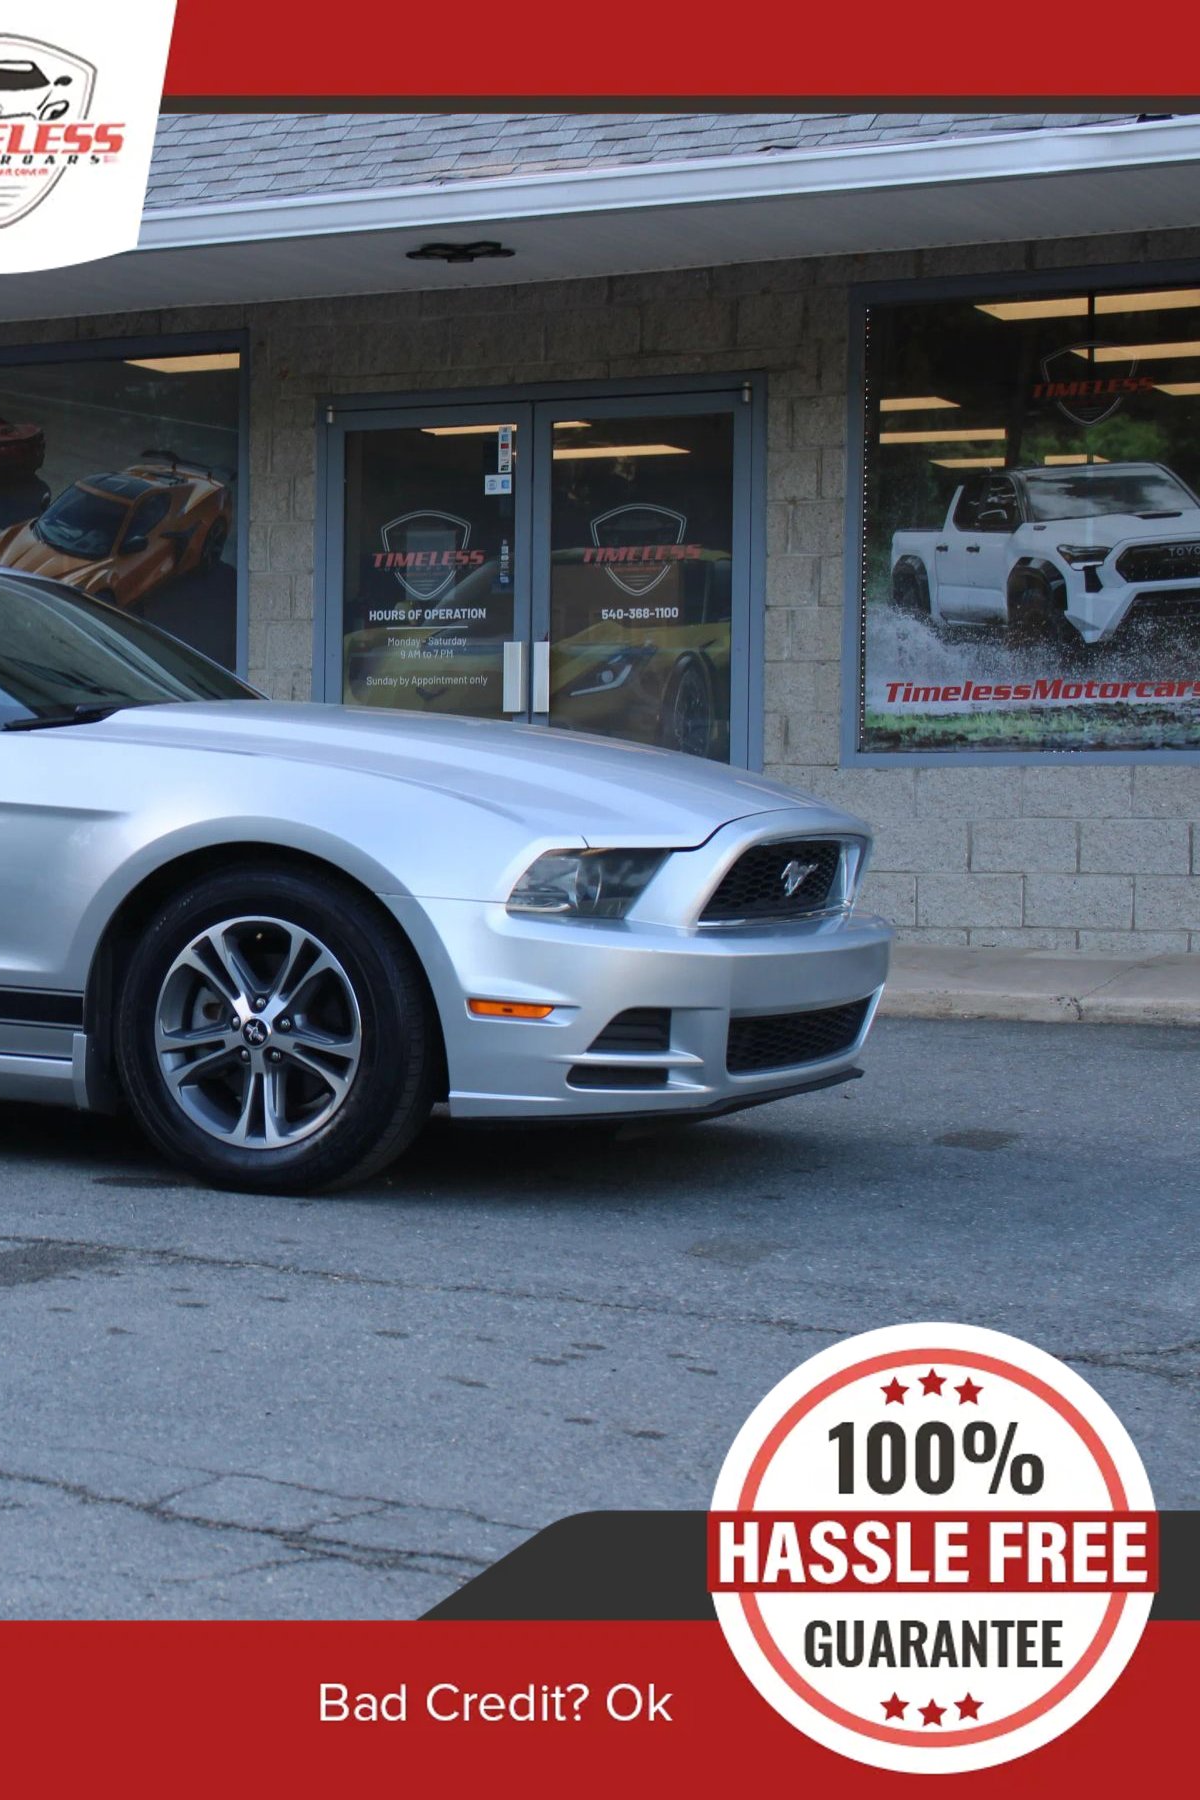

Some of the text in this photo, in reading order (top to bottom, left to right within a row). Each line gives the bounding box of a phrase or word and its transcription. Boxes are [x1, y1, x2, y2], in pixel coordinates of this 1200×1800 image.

[1032, 377, 1154, 398] TIMELESS
[372, 549, 485, 568] TIMELESS
[583, 544, 703, 562] TIMELESS
[369, 608, 487, 621] HOURS OF OPERATION
[601, 607, 679, 619] 540-368-1100
[388, 637, 420, 647] Monday
[428, 637, 467, 647] Saturday
[401, 650, 454, 659] 9 AM to 7 PM
[366, 675, 488, 687] Sunday by Appointment only
